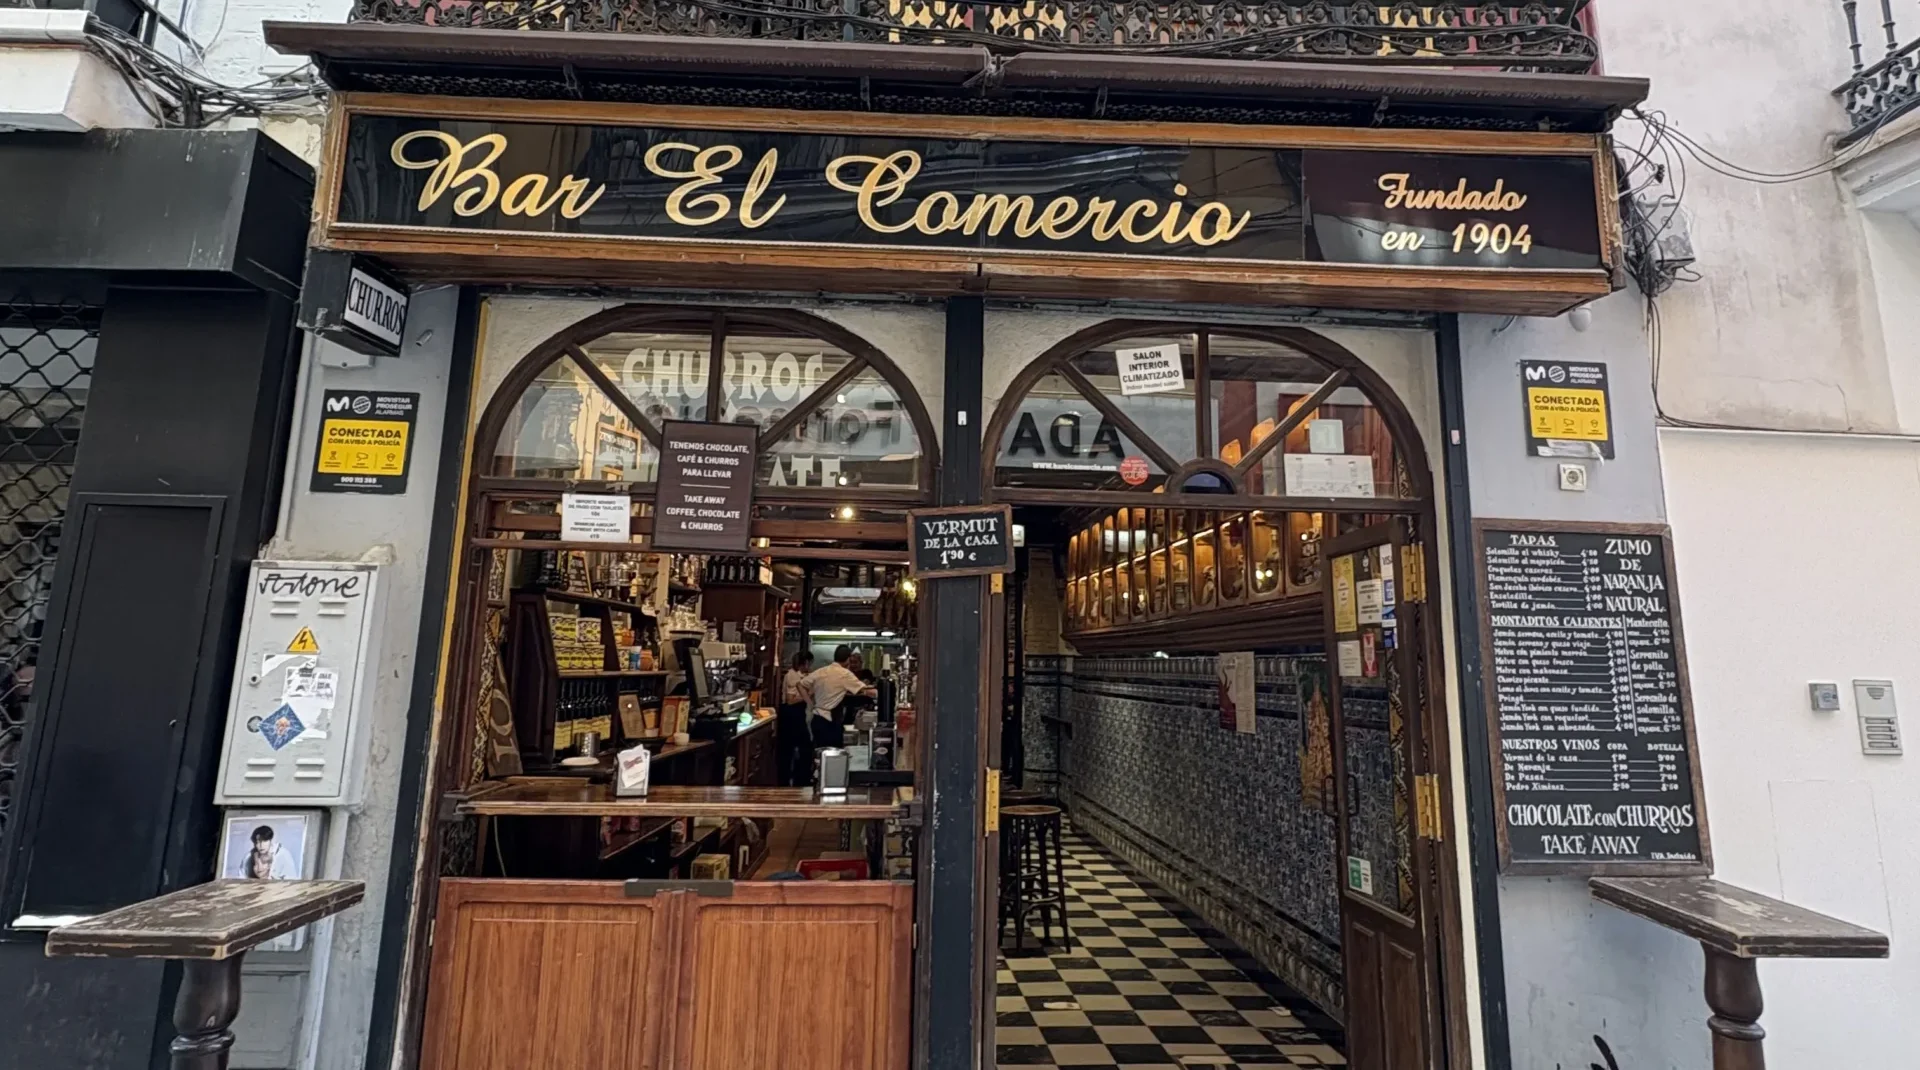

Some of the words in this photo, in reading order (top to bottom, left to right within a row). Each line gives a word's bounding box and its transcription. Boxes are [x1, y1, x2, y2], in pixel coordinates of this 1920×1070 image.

[390, 130, 606, 219] Bar
[644, 141, 786, 228] El
[825, 150, 1251, 246] Comercio
[1378, 173, 1527, 212] Fundado
[1381, 230, 1425, 251] en
[1452, 223, 1532, 255] 1904
[348, 277, 405, 335] CHURROS
[1133, 351, 1162, 361] SALON
[1129, 361, 1169, 372] INTERIOR
[622, 347, 823, 403] CHURROS
[1122, 369, 1180, 383] CLIMATIZADO
[1534, 396, 1600, 406] CONECTADA
[329, 428, 402, 439] CONECTADA
[669, 441, 704, 451] TENEMOS
[705, 443, 750, 454] CHOCOLATE,
[677, 454, 696, 464] CAFÉ
[697, 456, 703, 464] &
[705, 456, 739, 466] CHURROS
[682, 468, 702, 476] PARA
[703, 469, 732, 479] LLEVAR
[684, 495, 703, 504] TAKE
[704, 496, 726, 504] AWAY
[666, 507, 697, 517] COFFEE,
[698, 509, 740, 519] CHOCOLATE
[681, 521, 687, 530] &
[688, 522, 724, 531] CHURROS
[922, 518, 998, 536] VERMUT
[924, 538, 940, 549] DE
[943, 537, 961, 548] LA
[965, 534, 999, 546] CASA
[1510, 534, 1556, 546] TAPAS
[1604, 538, 1652, 556] ZUMO
[969, 552, 977, 561] €
[1531, 549, 1559, 558] whisky
[1488, 565, 1522, 575] Croquetas
[1619, 558, 1642, 572] DE
[1602, 573, 1664, 595] NARANJA
[1490, 592, 1533, 600] Ensaladilla
[1490, 600, 1518, 609] Tortilla
[1521, 601, 1529, 610] de
[1531, 602, 1556, 611] jamón
[1491, 615, 1560, 627] MONTADITOS
[1563, 616, 1622, 628] CALIENTES
[1567, 632, 1572, 640] y
[1630, 649, 1668, 660] Serranito
[1631, 661, 1642, 670] de
[1668, 693, 1678, 703] de
[1502, 739, 1558, 752] NUESTROS
[1562, 739, 1600, 751] VINOS
[1607, 742, 1628, 751] COPA
[1647, 743, 1684, 752] BOTELLA
[1504, 753, 1533, 762] Vermut
[1536, 754, 1545, 762] de
[1546, 754, 1556, 762] la
[1504, 763, 1515, 771] De
[1518, 763, 1551, 773] Naranja
[1505, 773, 1516, 782] De
[1518, 774, 1545, 782] Pasas
[1506, 783, 1530, 791] Pedro
[1531, 782, 1565, 791] Ximénez
[1508, 803, 1594, 826] CHOCOLATE
[1616, 804, 1694, 834] CHURROS
[1541, 834, 1586, 855] TAKE
[1591, 835, 1640, 854] AWAY
